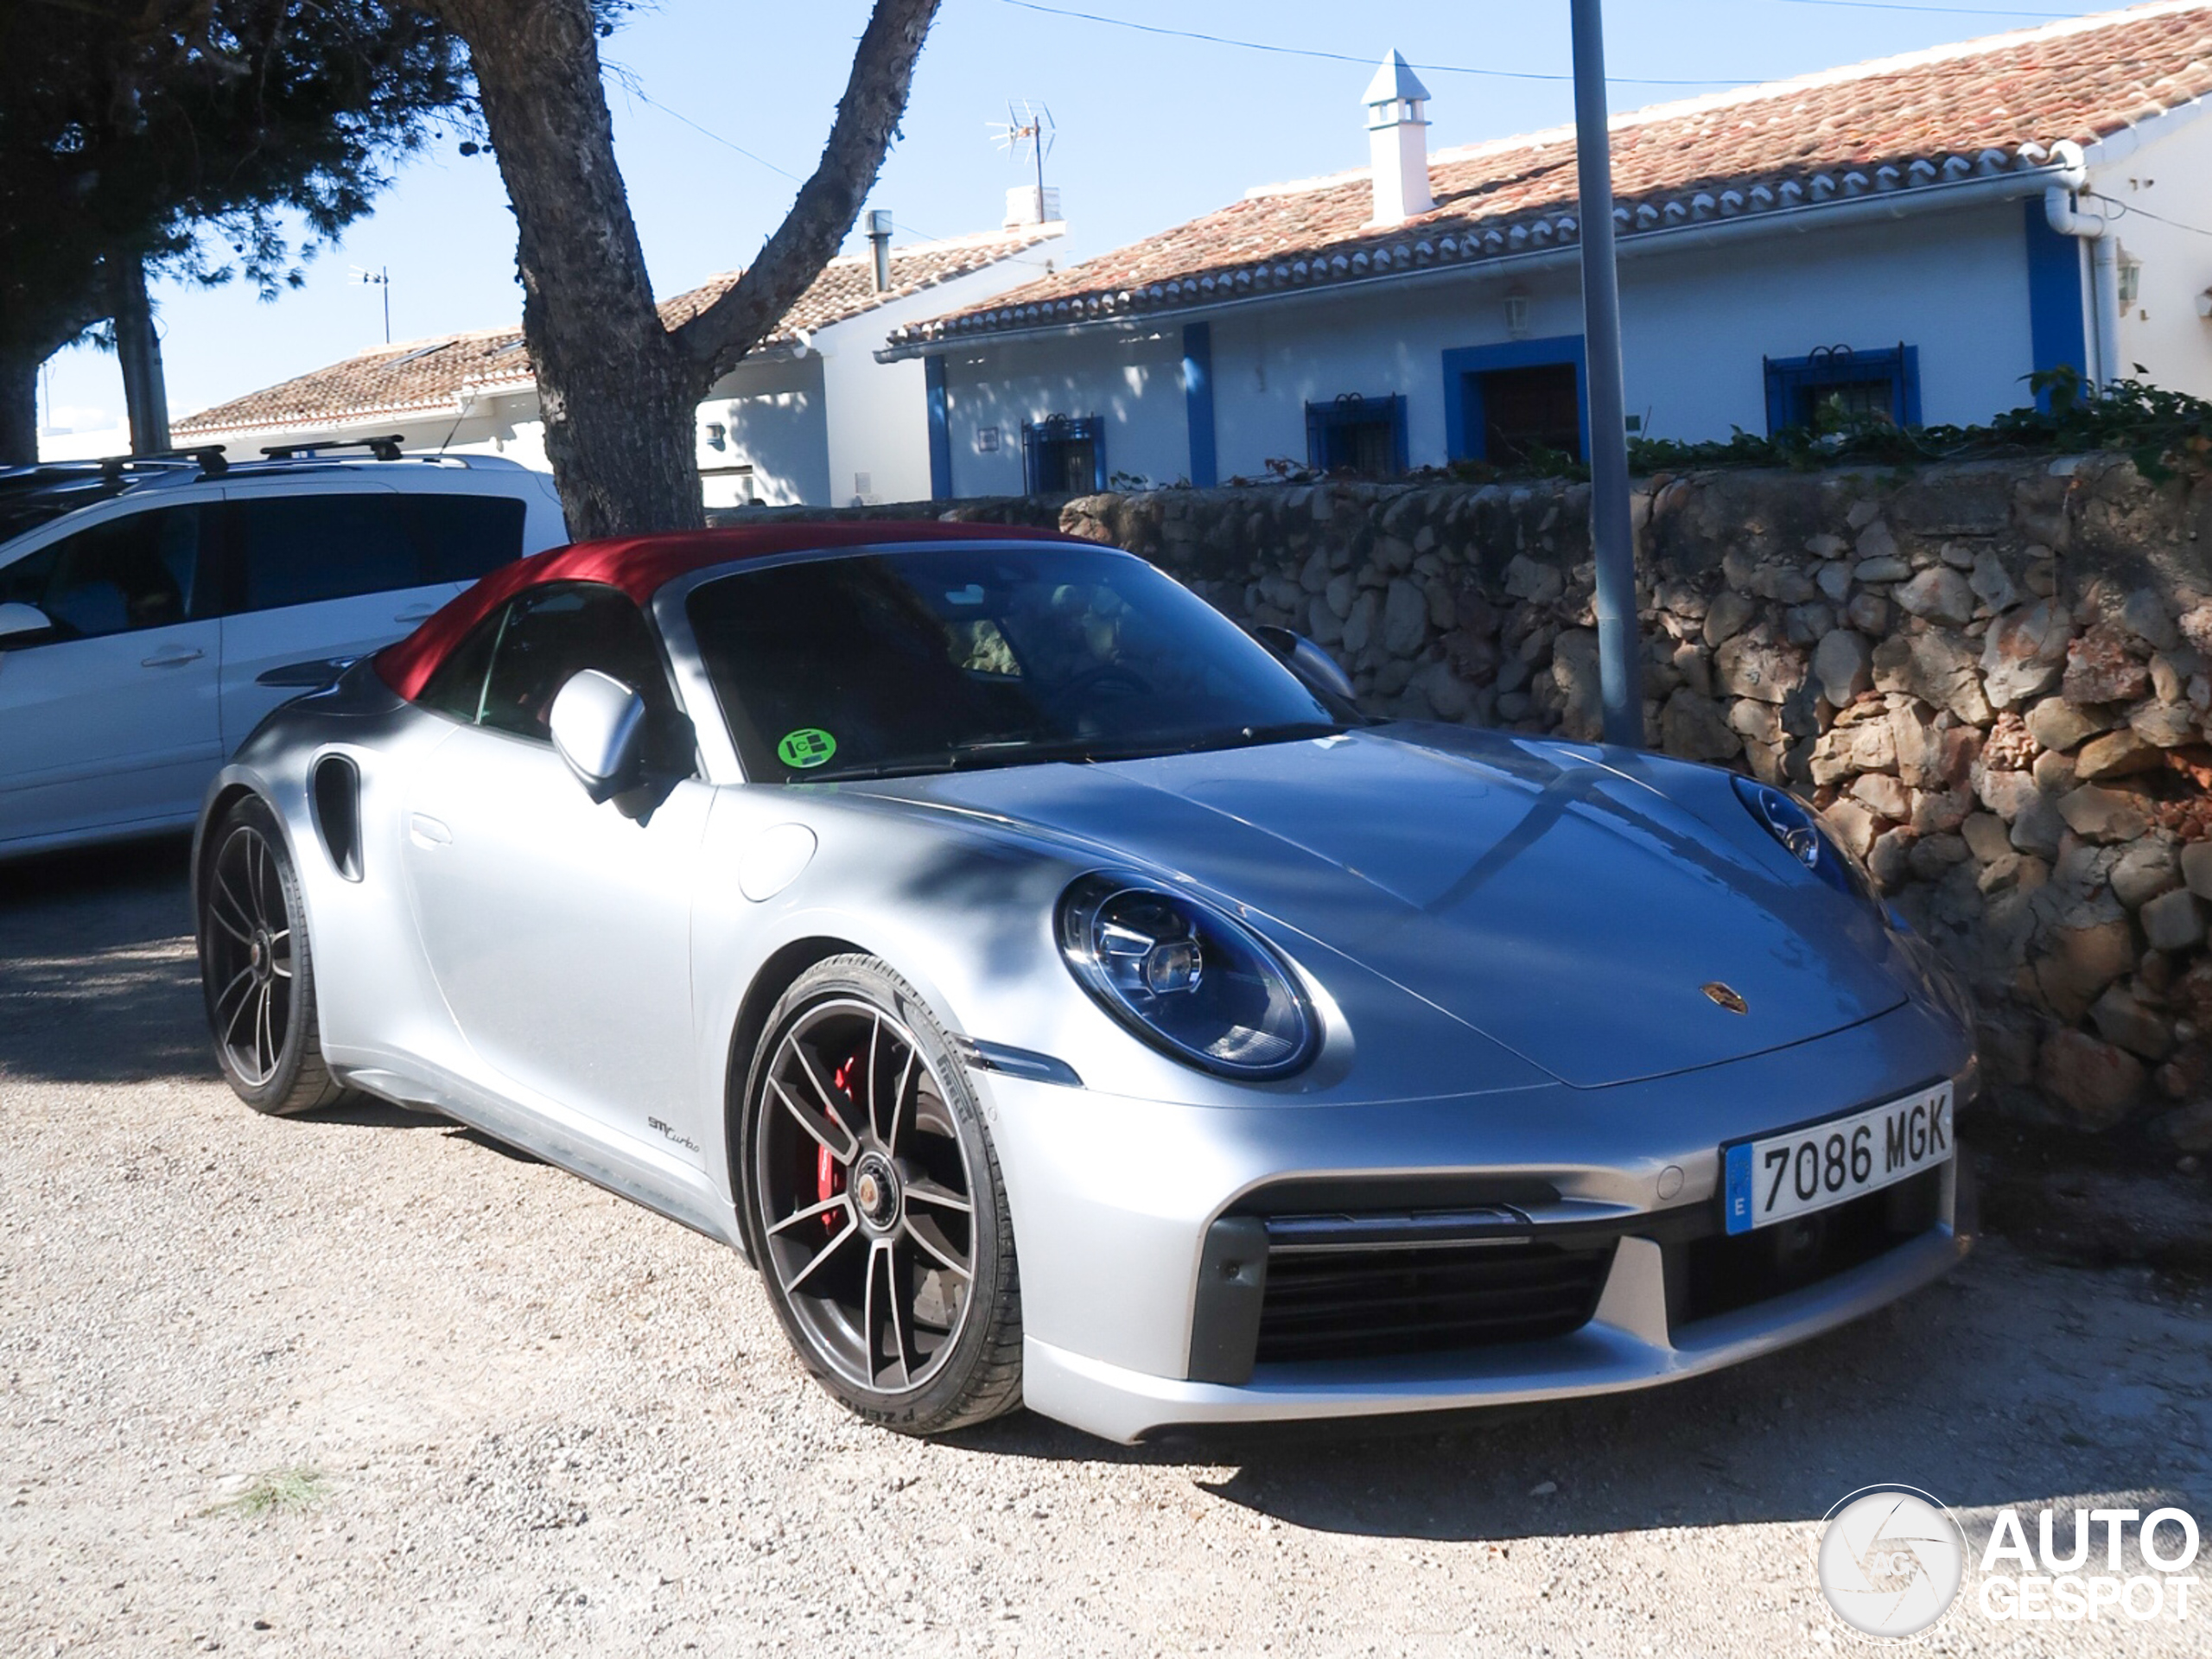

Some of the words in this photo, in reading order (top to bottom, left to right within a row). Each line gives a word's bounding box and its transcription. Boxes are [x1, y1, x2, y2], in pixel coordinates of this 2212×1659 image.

[937, 1054, 973, 1123] PIRELLI
[1765, 1141, 1872, 1211] 7086
[1886, 1095, 1947, 1173] MGK
[1735, 1198, 1745, 1215] E
[838, 1395, 896, 1423] ZERO
